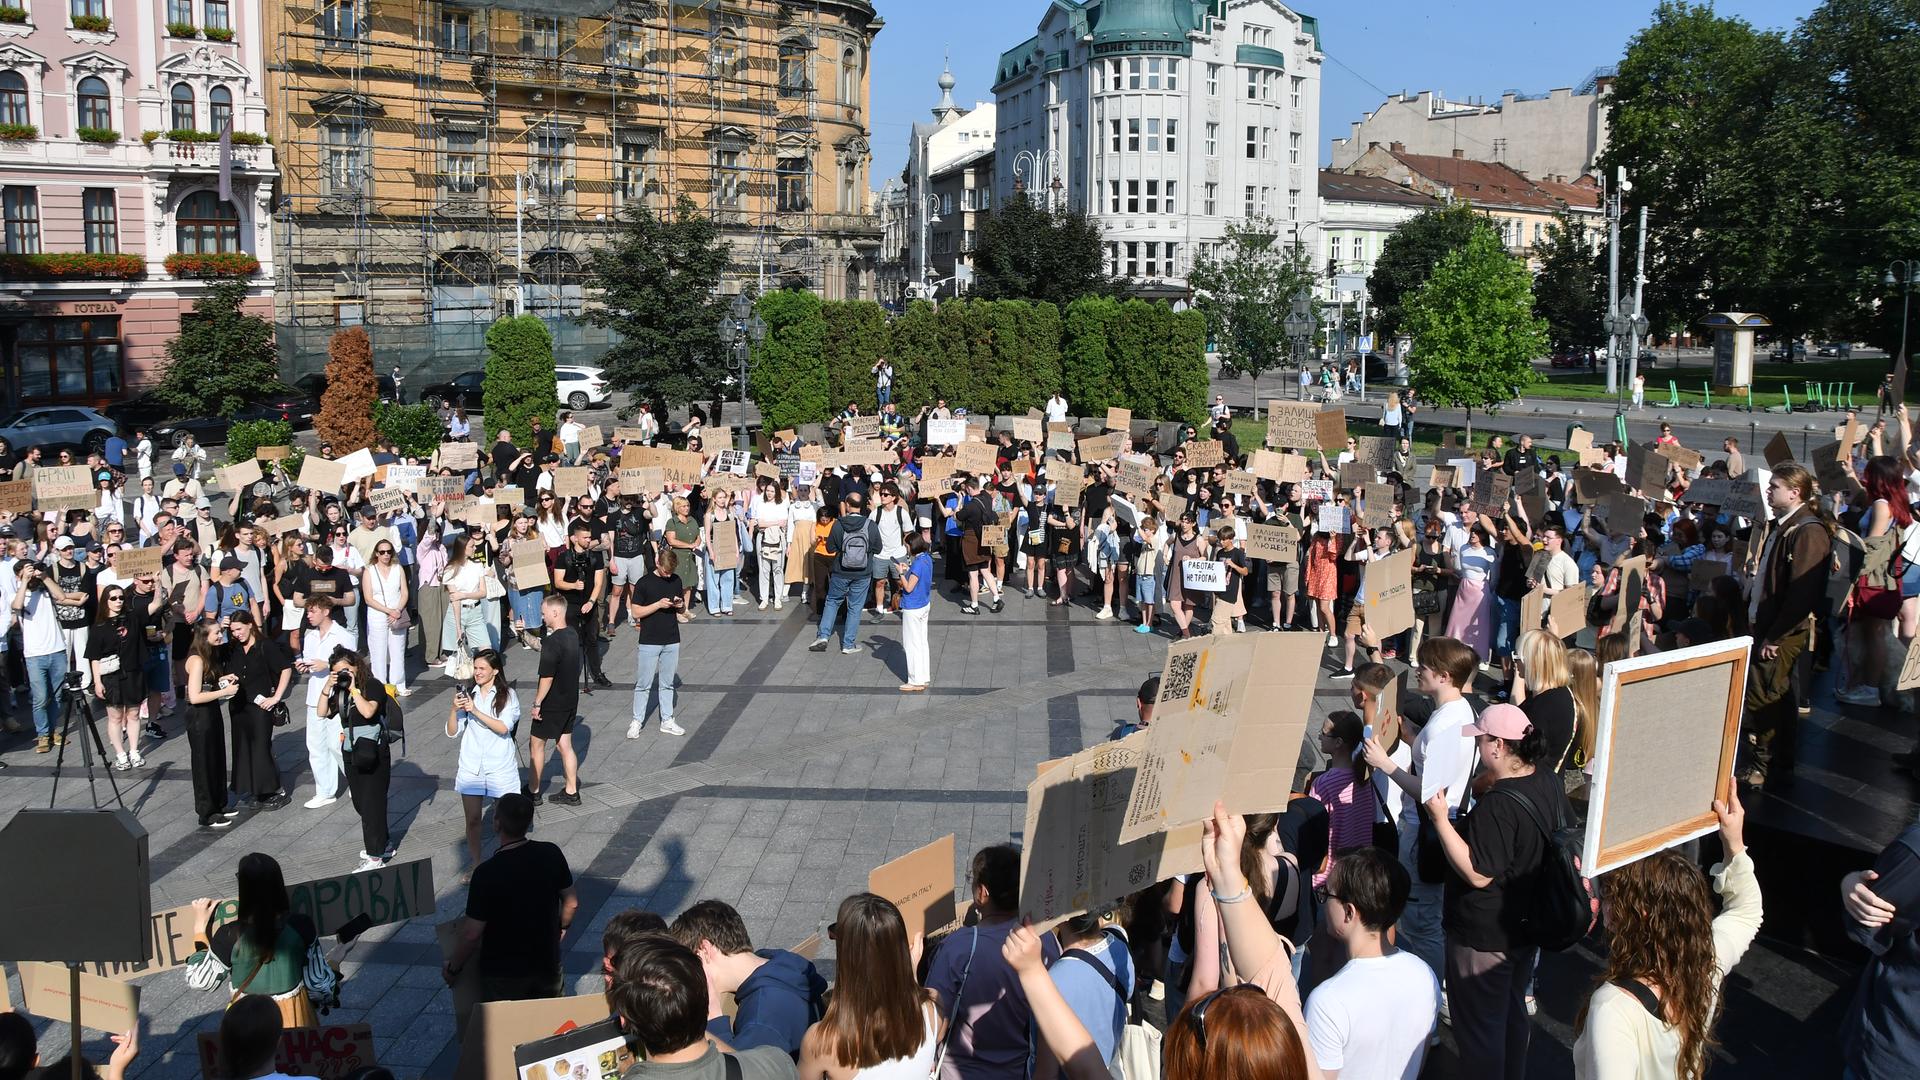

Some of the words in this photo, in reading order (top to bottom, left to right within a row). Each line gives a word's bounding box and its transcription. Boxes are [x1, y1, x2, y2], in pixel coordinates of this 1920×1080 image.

[1140, 41, 1178, 51] ЦЕНТР
[74, 303, 117, 313] ГОТЕЛЬ
[1277, 406, 1319, 419] ЗАЛИШ
[1269, 428, 1317, 440] МІНІСТРОМ
[1254, 543, 1288, 553] ЛЮДЕЙ
[1194, 573, 1217, 583] ТРОГАЙ
[895, 894, 911, 908] MADE
[911, 890, 918, 899] IN
[918, 883, 933, 896] ITALY
